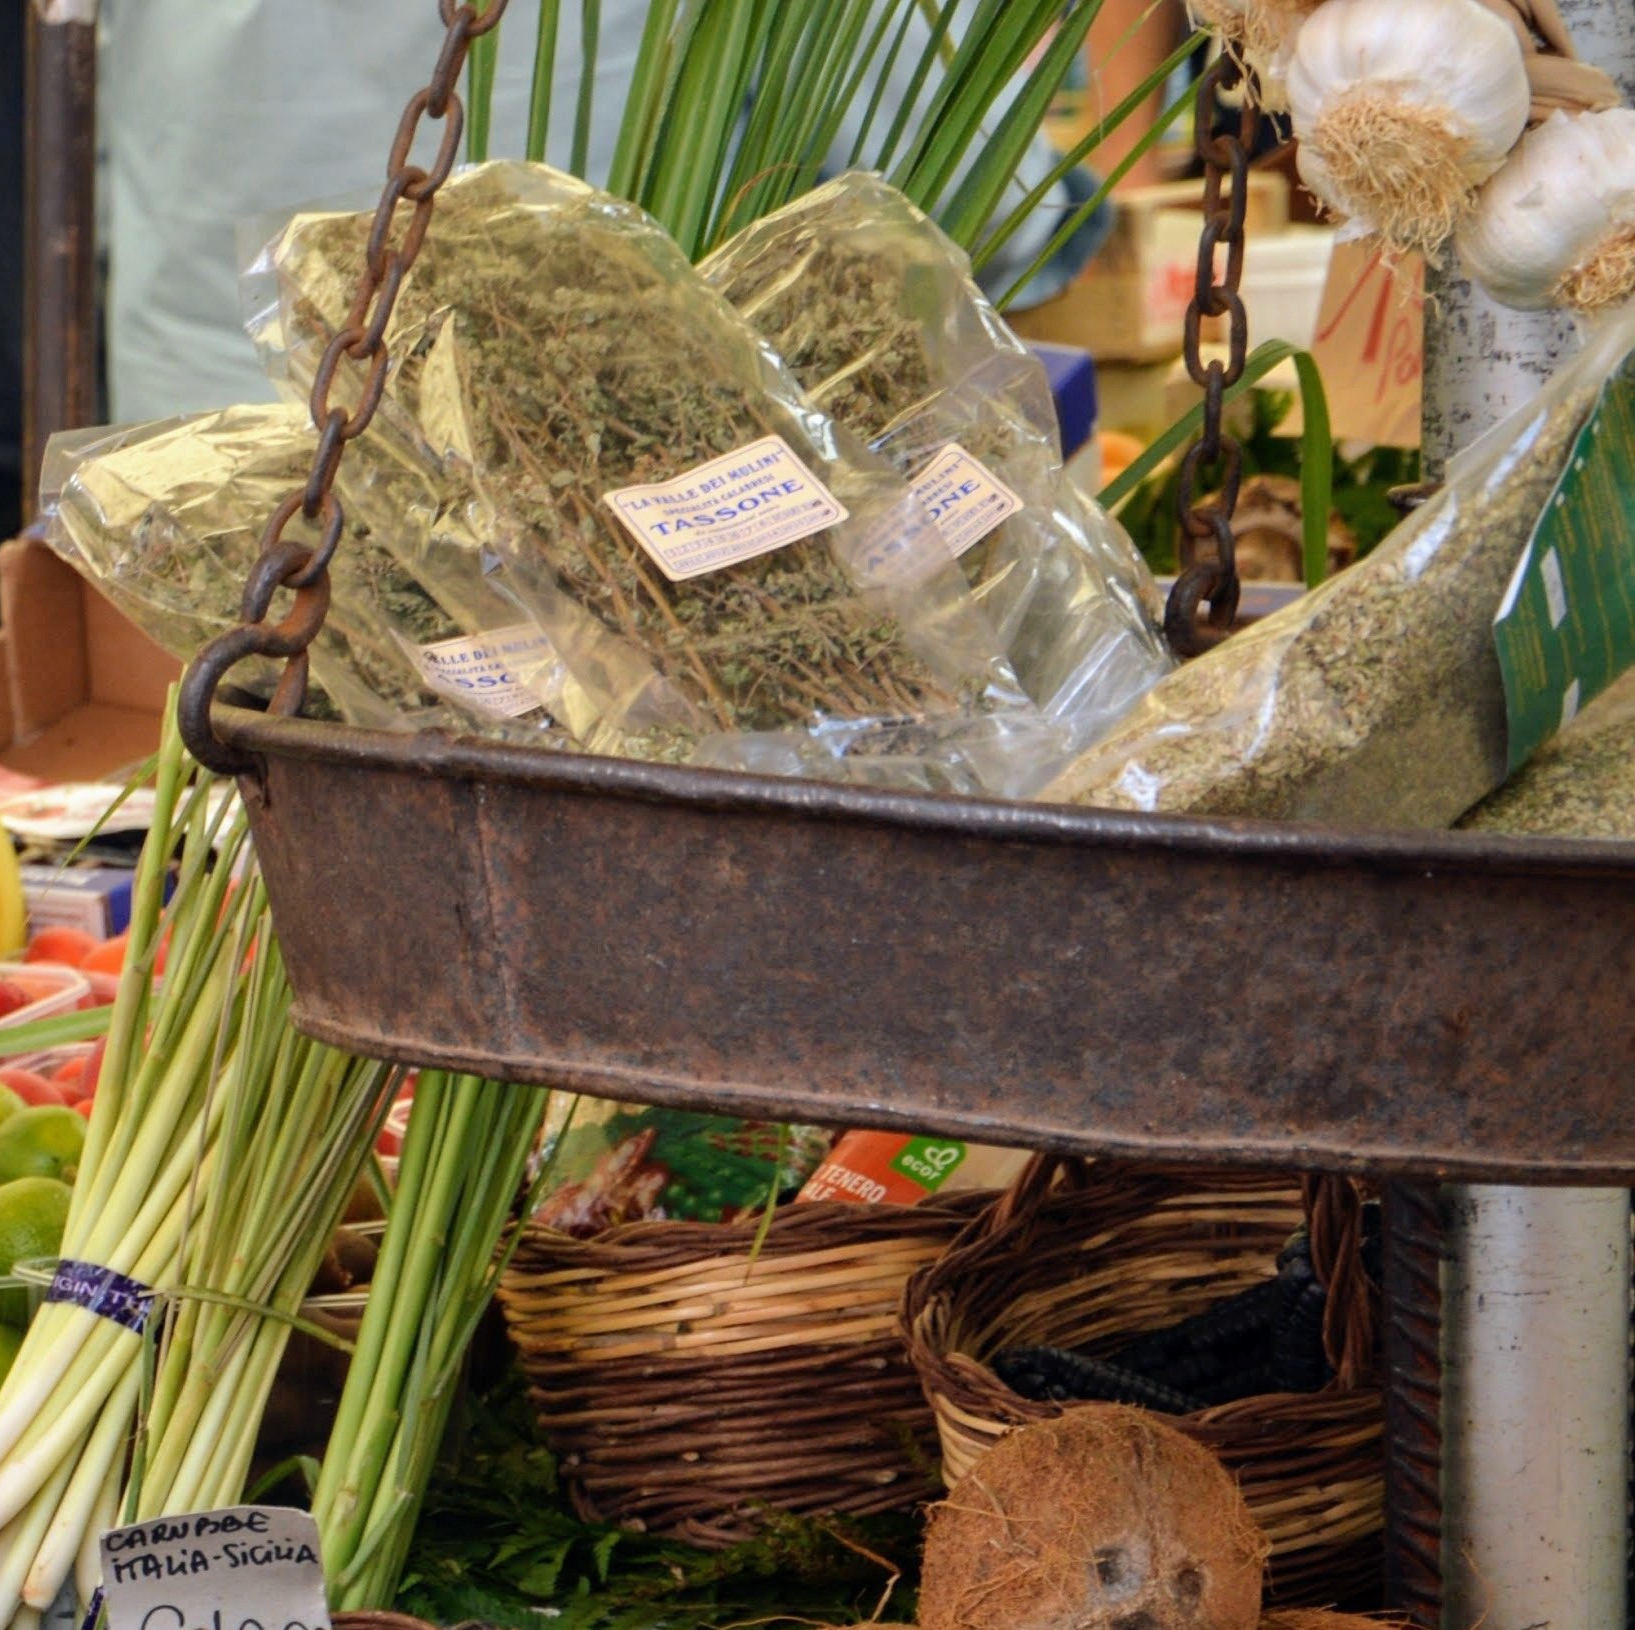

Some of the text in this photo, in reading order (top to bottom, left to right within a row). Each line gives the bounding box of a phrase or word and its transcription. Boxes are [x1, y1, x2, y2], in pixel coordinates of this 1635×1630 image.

[699, 475, 728, 495] DEI
[649, 478, 805, 537] TASSONE
[900, 1154, 943, 1182] ecor
